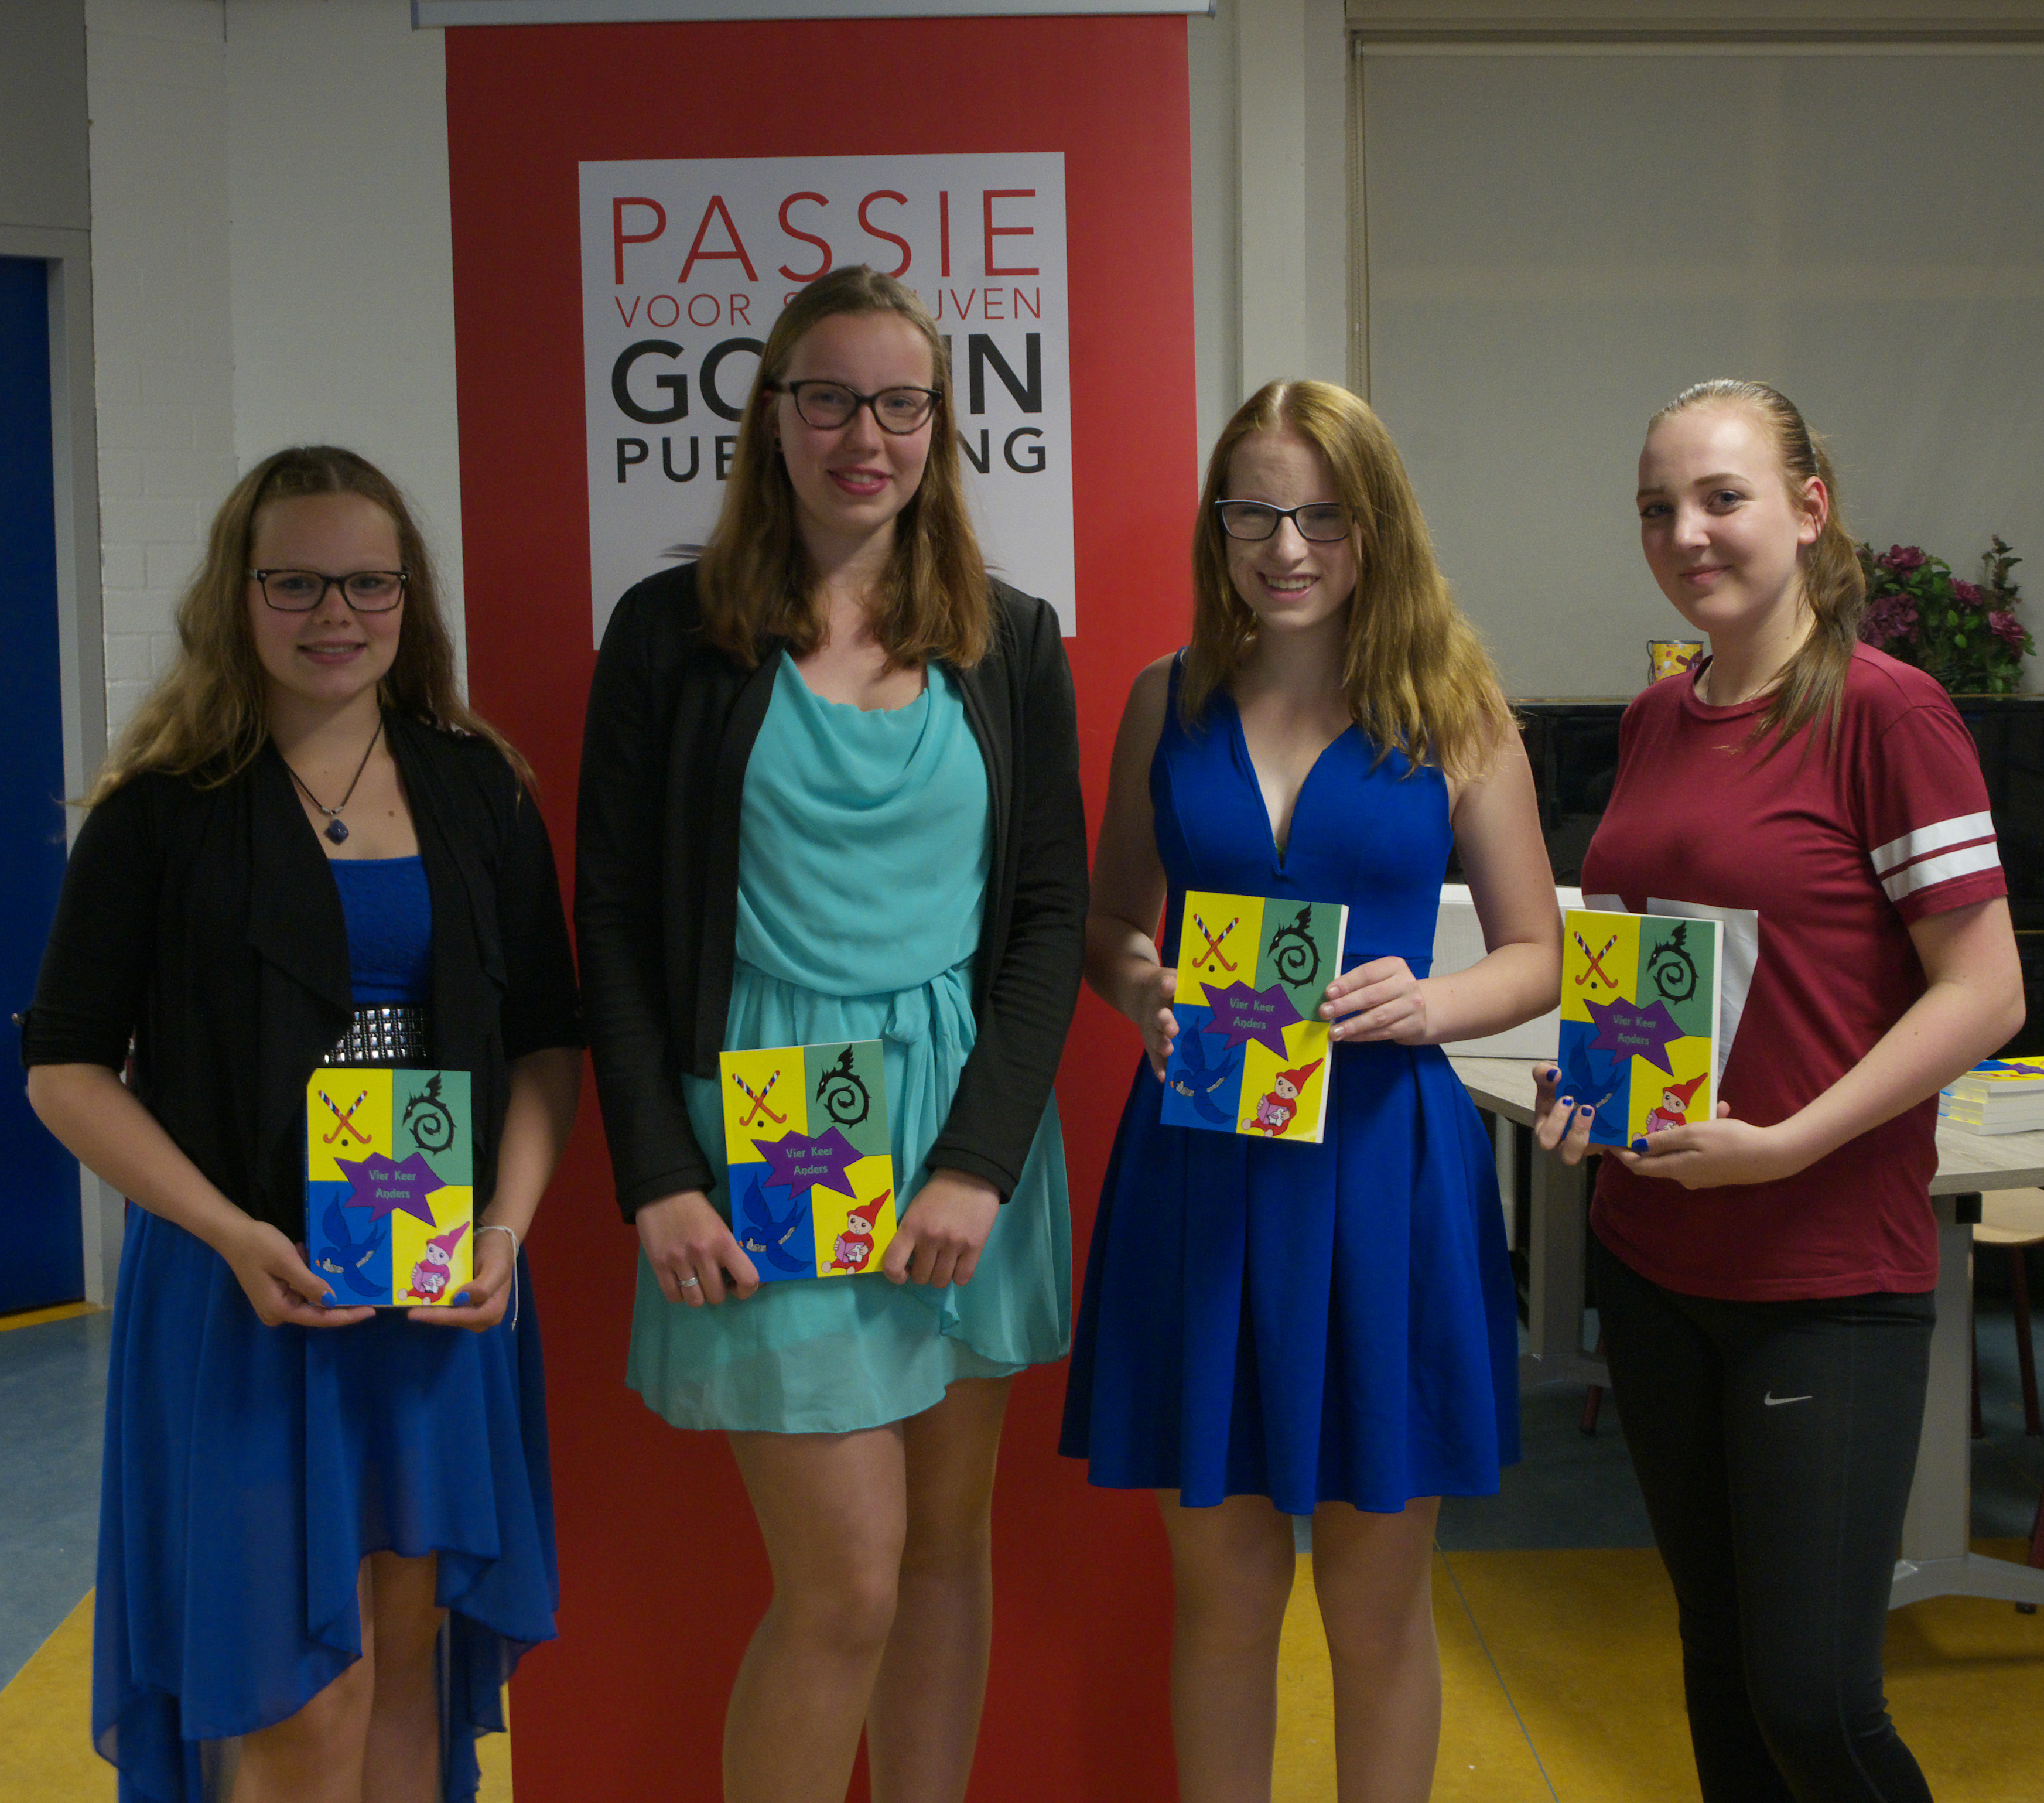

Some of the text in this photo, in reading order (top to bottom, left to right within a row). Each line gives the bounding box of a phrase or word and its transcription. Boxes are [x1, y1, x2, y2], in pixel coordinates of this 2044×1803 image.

[612, 189, 1040, 285] PASSIE
[615, 293, 751, 328] VOOR
[1230, 998, 1275, 1012] Vier Keer
[1233, 1016, 1266, 1030] Anders
[786, 1146, 833, 1158] Vier Keer
[395, 1170, 416, 1181] Keer
[794, 1164, 828, 1176] Anders
